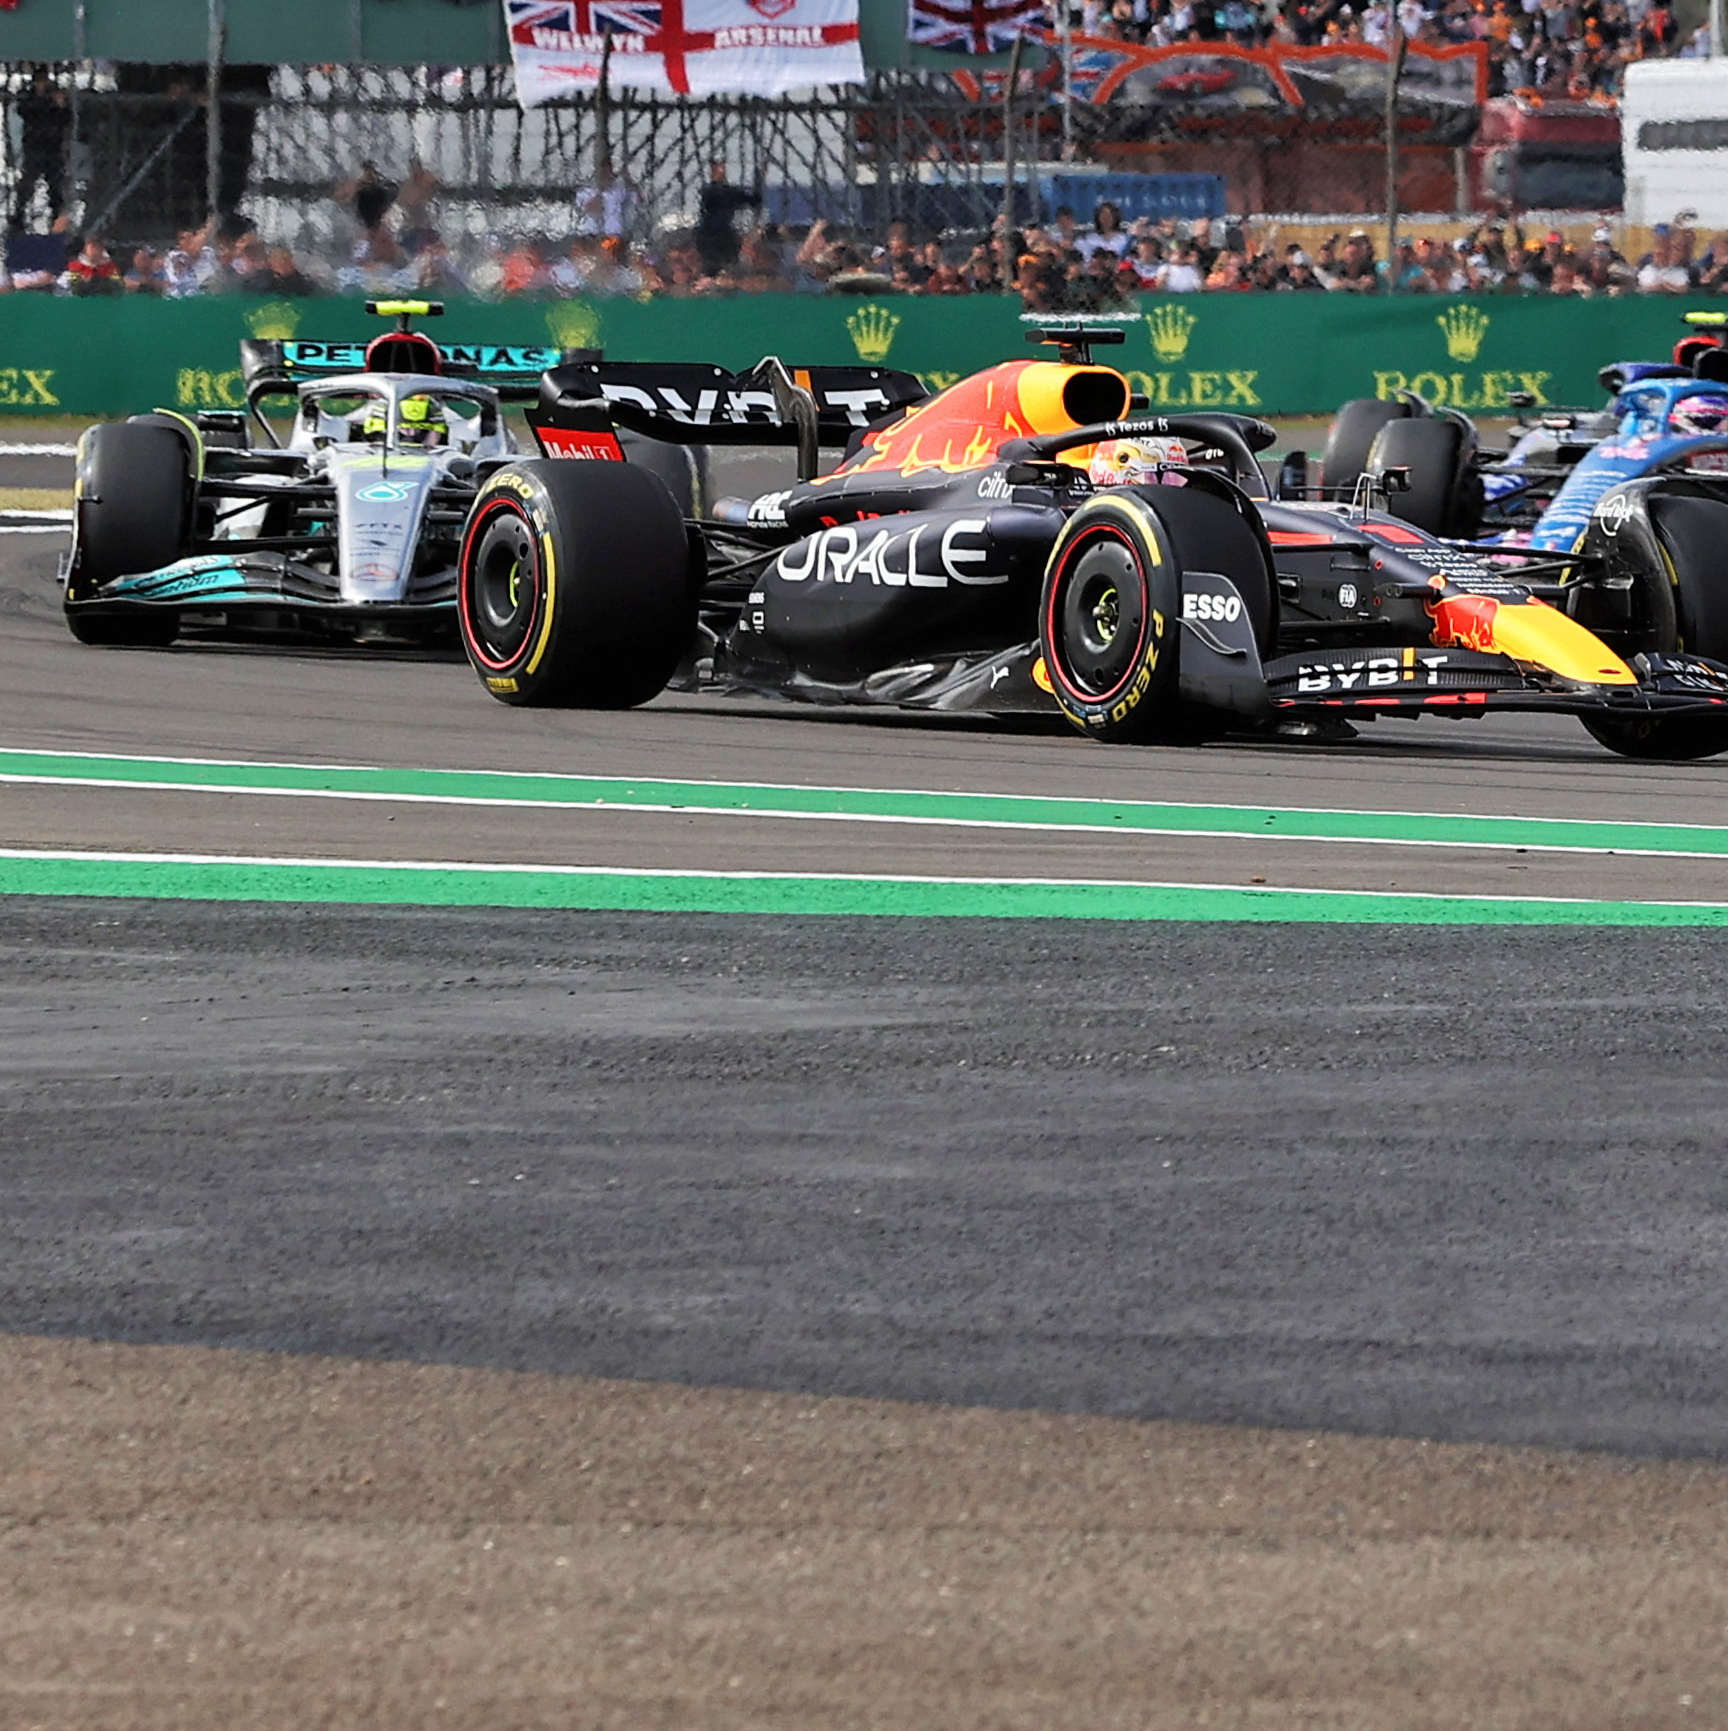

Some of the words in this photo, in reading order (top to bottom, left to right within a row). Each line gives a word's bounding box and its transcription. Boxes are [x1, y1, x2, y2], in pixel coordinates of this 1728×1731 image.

[714, 26, 824, 48] ARSENAL
[299, 344, 550, 368] PENAS
[1131, 370, 1262, 406] OLEX
[1373, 371, 1552, 407] ROLEX
[1118, 421, 1155, 432] Tezos
[544, 440, 594, 460] Mobil
[776, 517, 1009, 588] ORACLE
[1183, 593, 1242, 622] ESSO
[1111, 642, 1160, 722] ZERO
[1297, 647, 1448, 692] BYBIT
